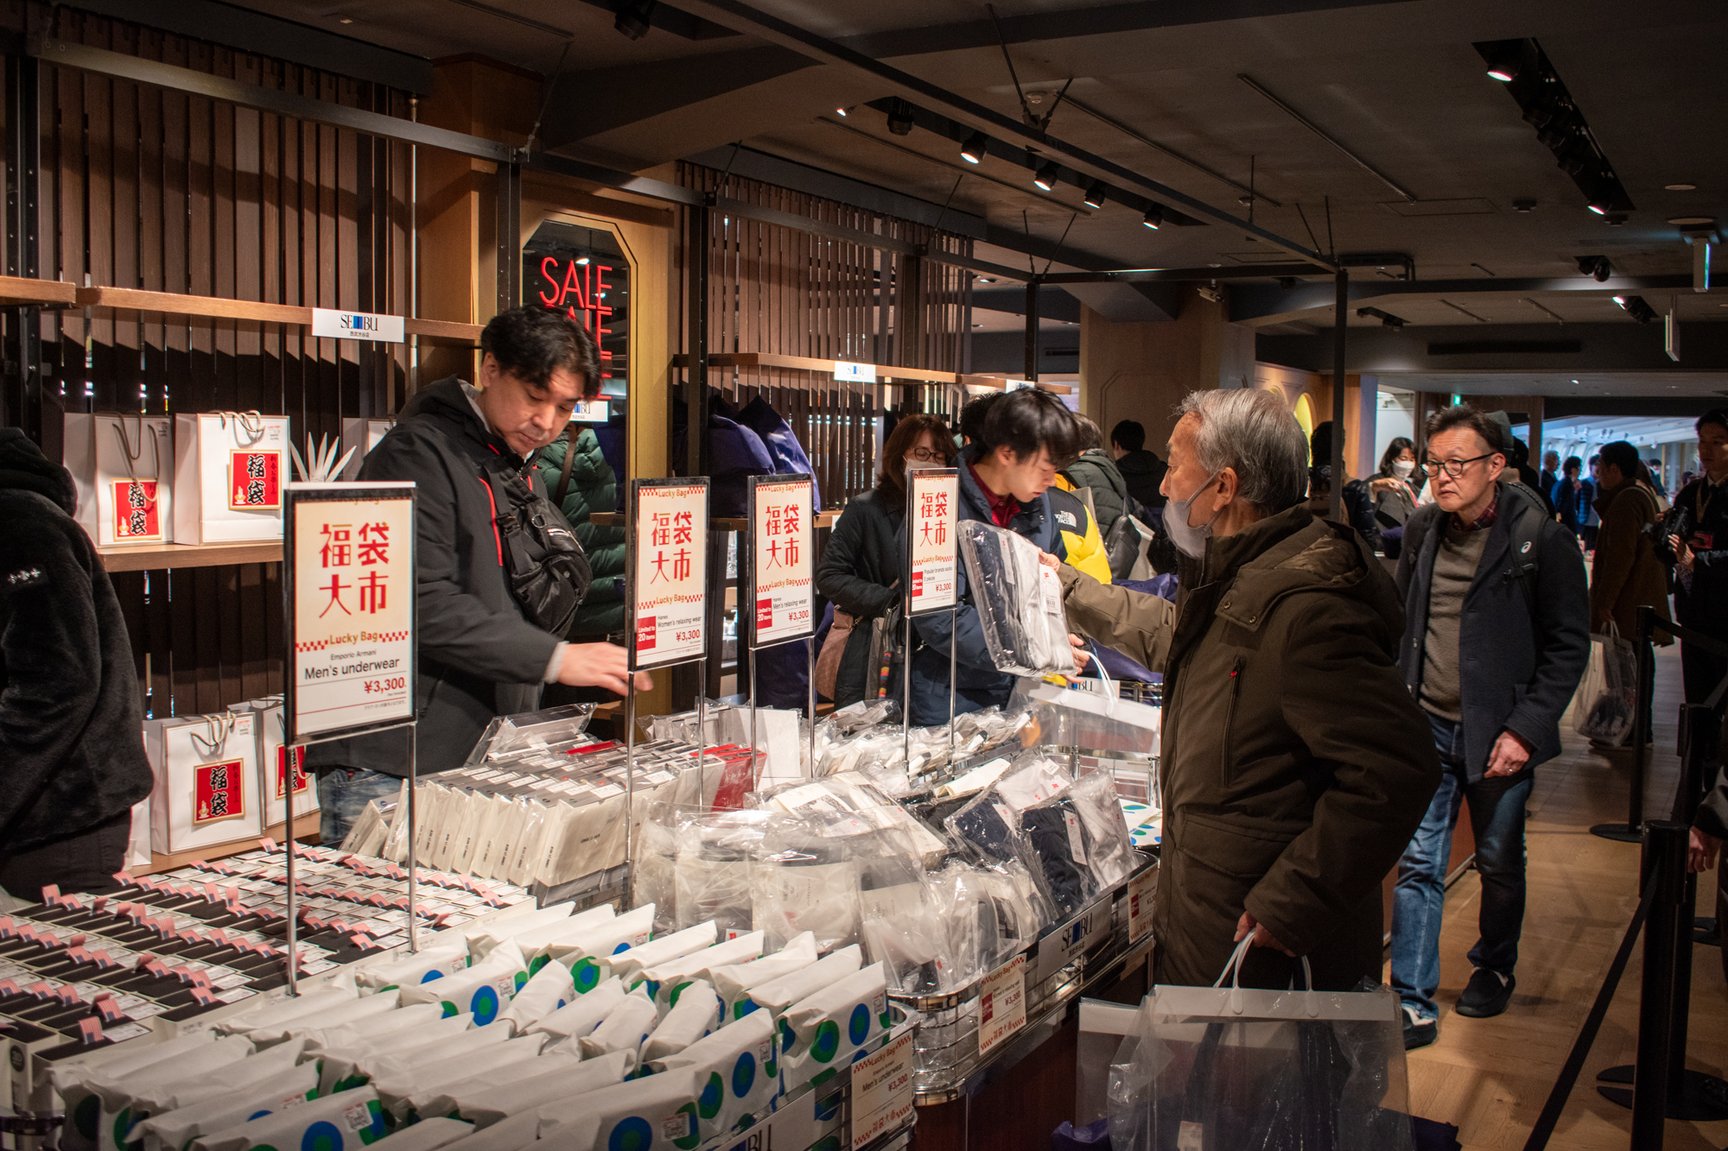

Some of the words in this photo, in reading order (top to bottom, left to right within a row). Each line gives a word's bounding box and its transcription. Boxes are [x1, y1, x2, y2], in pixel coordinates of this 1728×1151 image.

[539, 256, 612, 310] SALE
[340, 314, 378, 331] SEIBU
[248, 454, 266, 505] 福袋
[658, 490, 675, 499] Lucky
[676, 489, 687, 498] Bag
[920, 491, 947, 518] 福袋
[651, 511, 692, 546] 福袋
[765, 504, 799, 536] 福袋
[920, 520, 947, 547] 大市
[319, 522, 390, 568] 福袋
[766, 537, 799, 569] 大市
[650, 548, 692, 584] 大市
[319, 571, 390, 618] 大市
[656, 595, 674, 605] Lucky
[673, 593, 685, 603] Bag
[788, 610, 809, 621] ¥3,300
[329, 633, 358, 646] Lucky
[360, 631, 378, 643] Bag
[675, 629, 701, 642] ¥3,300
[330, 651, 355, 661] Emporio
[356, 649, 377, 658] Armani
[305, 665, 338, 680] Men's
[341, 658, 400, 675] underwear
[363, 676, 406, 694] ¥3,300
[210, 765, 228, 817] 福袋
[1061, 912, 1093, 952] SEIBU
